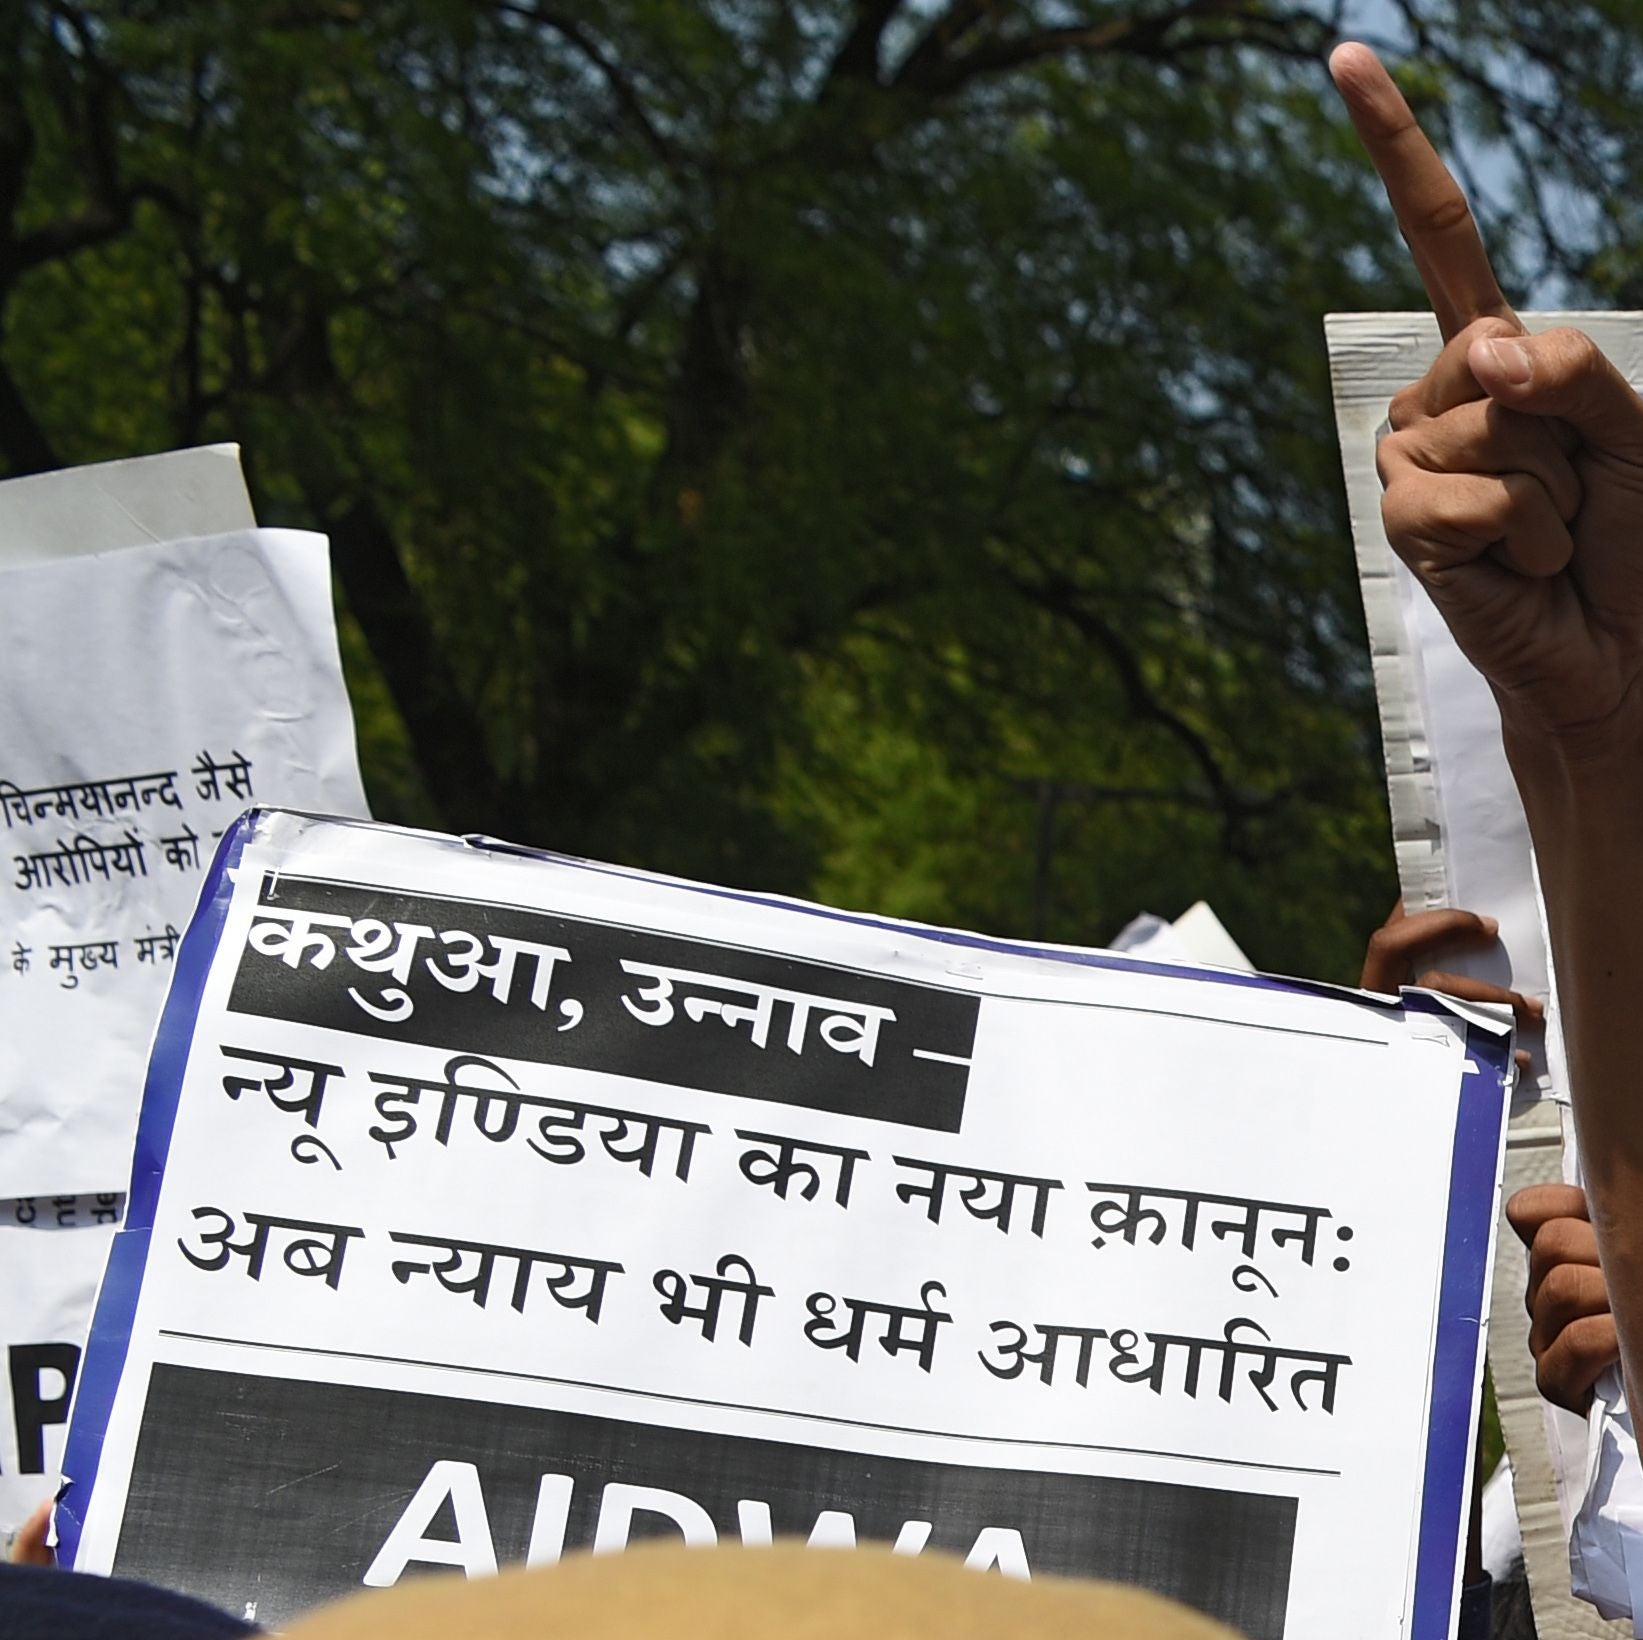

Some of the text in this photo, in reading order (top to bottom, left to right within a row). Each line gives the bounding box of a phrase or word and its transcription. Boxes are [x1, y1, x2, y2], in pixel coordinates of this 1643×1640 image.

[191, 750, 253, 802] जैसे
[14, 823, 201, 890] आरोपियों को
[48, 941, 119, 990] मुख्य
[248, 905, 585, 1031] कथुआ,
[620, 958, 897, 1067] उन्नाव
[218, 1044, 344, 1171] न्यू
[366, 1055, 712, 1184] इण्डिया
[734, 1128, 871, 1209] का
[891, 1155, 1065, 1239] नया
[178, 1206, 1352, 1416] अब न्याय भी धर्म आधारित
